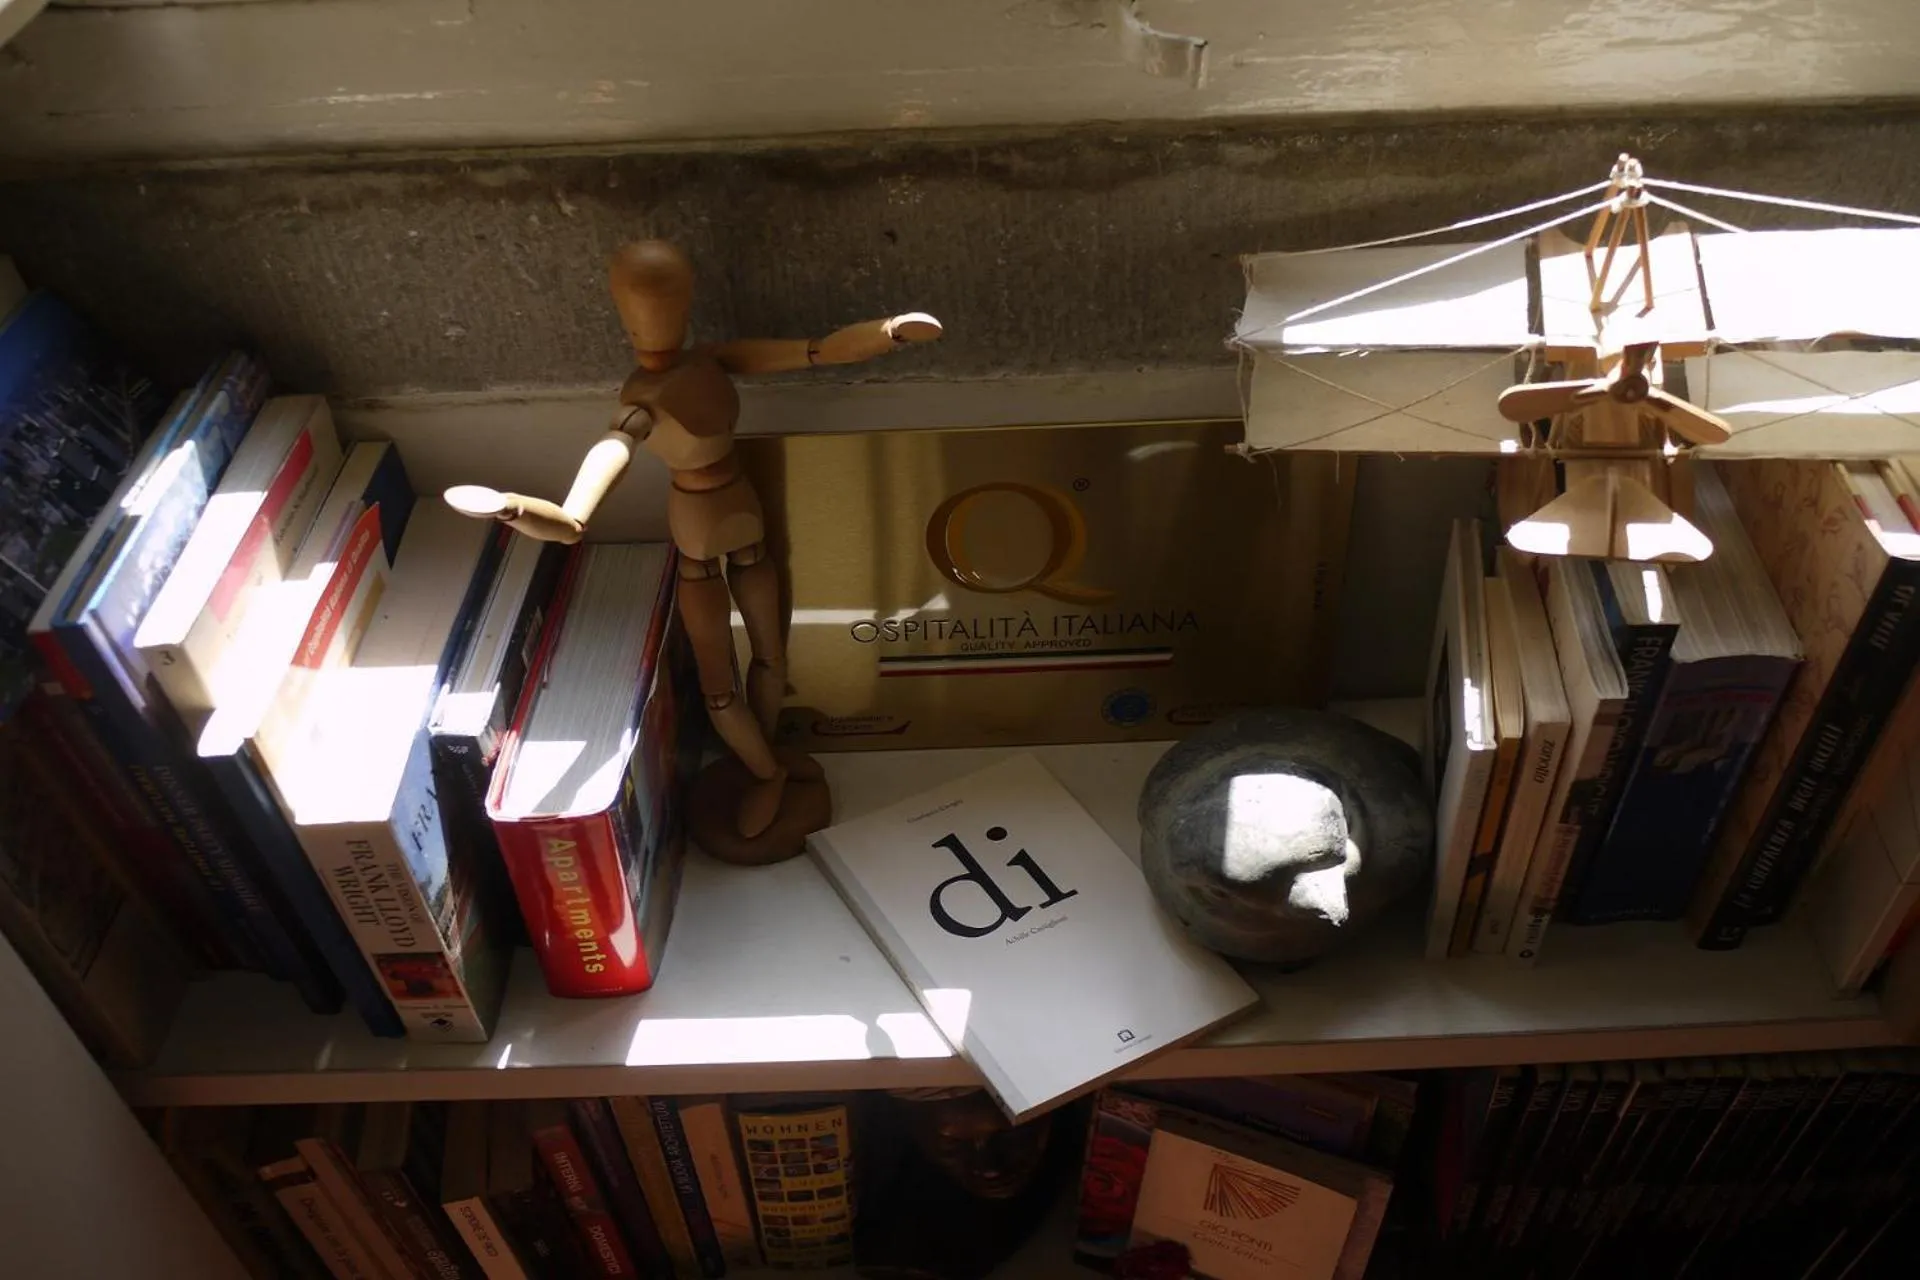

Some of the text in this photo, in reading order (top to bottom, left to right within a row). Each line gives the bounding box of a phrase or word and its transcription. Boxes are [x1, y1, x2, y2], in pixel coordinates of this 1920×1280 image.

[850, 610, 1200, 643] OSPITALITÀ ITALIANA
[960, 638, 1092, 652] QUALITY APPROVED
[334, 866, 380, 926] WRIGHT
[346, 840, 416, 947] FRANK LLOYD
[548, 839, 607, 974] Apartments
[930, 826, 1079, 938] di
[744, 1117, 843, 1135] WOHNEN
[553, 1151, 623, 1276] INTERNI DOMESTICI
[1231, 1230, 1273, 1251] PONTI
